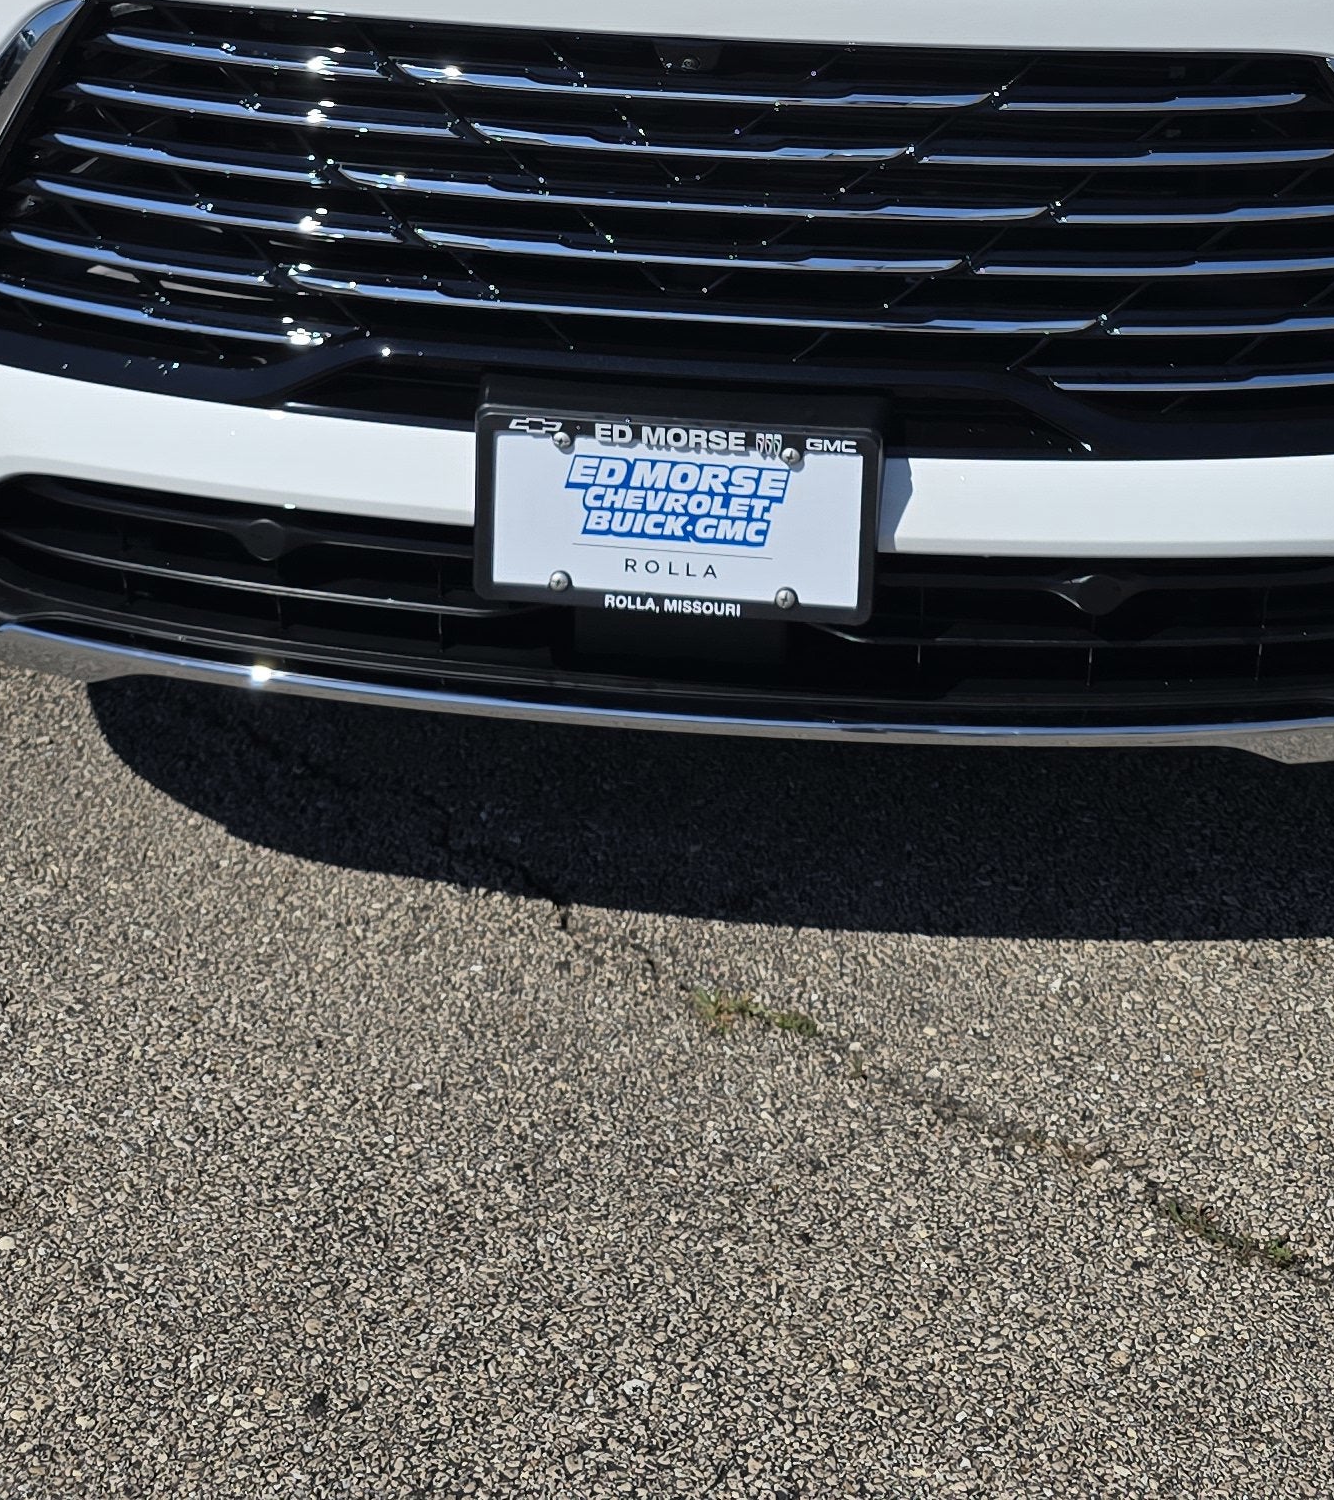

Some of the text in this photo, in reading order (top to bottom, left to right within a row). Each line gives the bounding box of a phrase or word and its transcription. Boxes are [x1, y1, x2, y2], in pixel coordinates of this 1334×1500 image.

[594, 423, 858, 454] ED MORSE GMC
[568, 456, 789, 498] ED MORSE
[624, 557, 718, 579] ROLLA
[604, 594, 742, 617] ROLLA, MISSOURI
